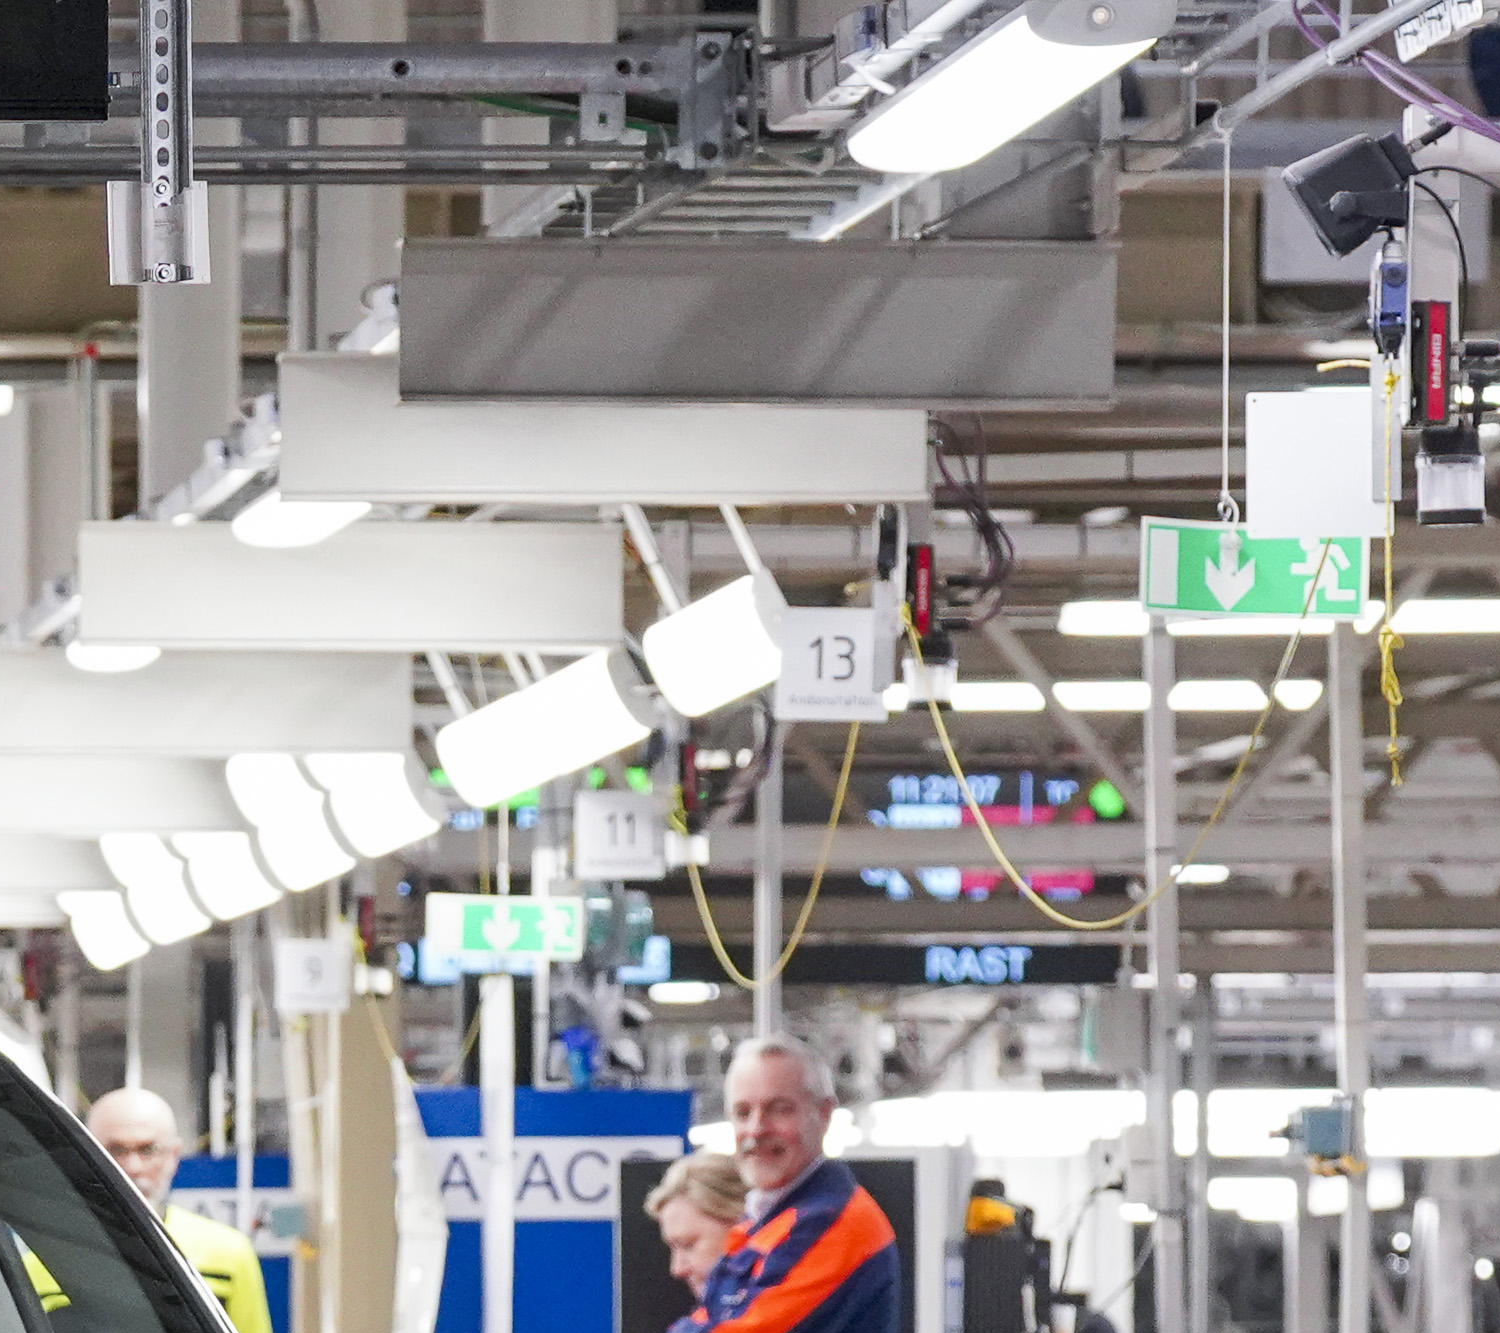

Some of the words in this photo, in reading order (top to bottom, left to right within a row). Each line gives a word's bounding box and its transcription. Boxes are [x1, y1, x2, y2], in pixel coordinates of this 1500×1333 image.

[809, 635, 856, 681] 13
[605, 811, 637, 847] 11
[924, 945, 1033, 984] RAST
